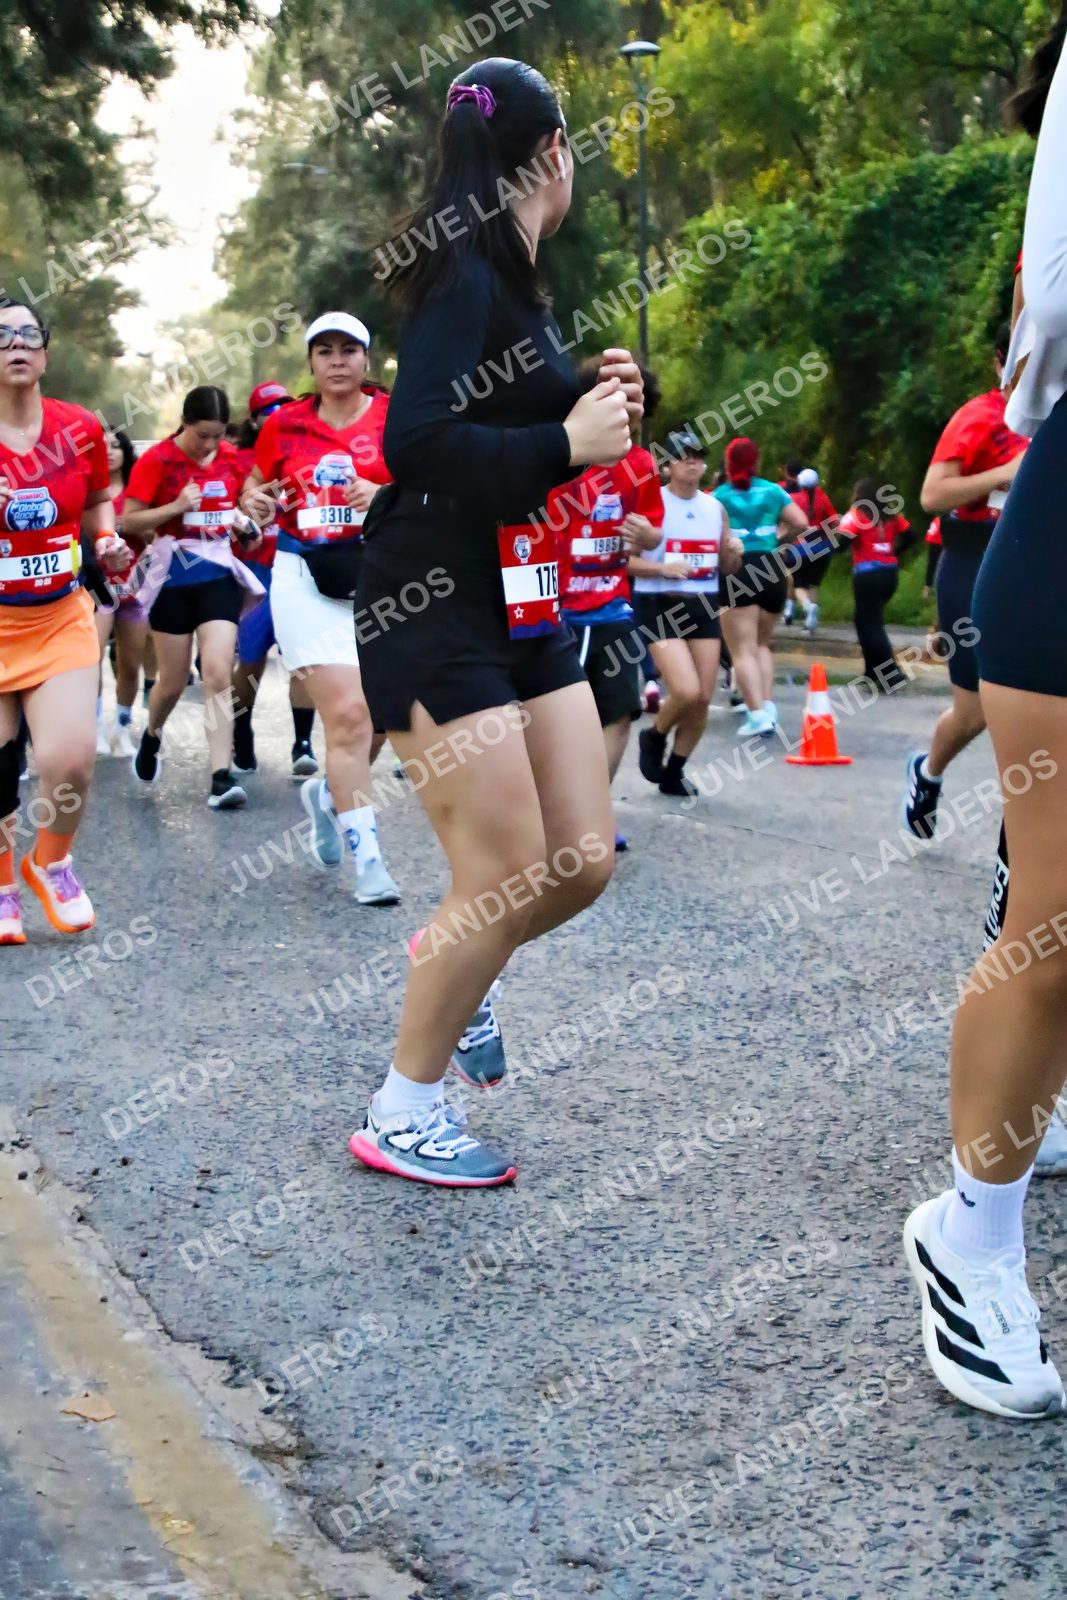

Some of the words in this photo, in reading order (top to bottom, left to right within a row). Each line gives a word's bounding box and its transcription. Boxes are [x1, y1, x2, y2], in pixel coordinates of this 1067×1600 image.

[320, 507, 352, 523] 3318
[594, 537, 618, 553] 1985
[21, 553, 60, 577] 3212
